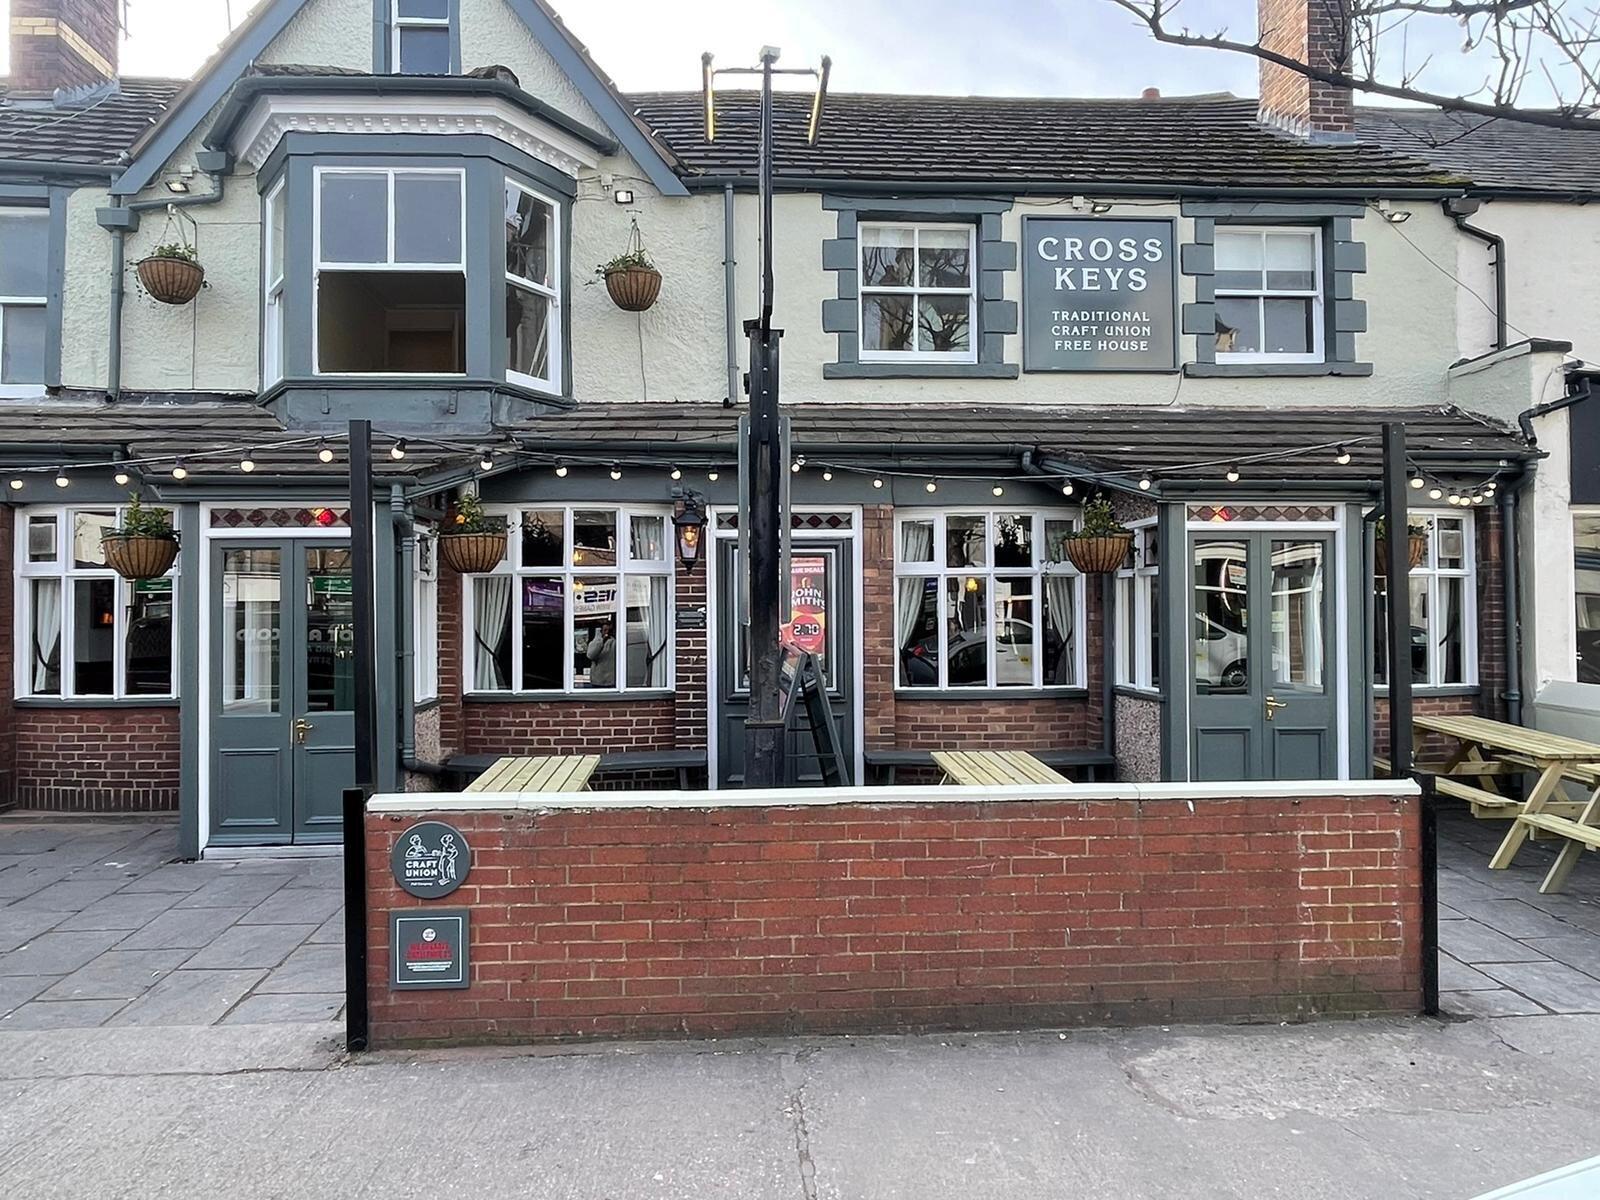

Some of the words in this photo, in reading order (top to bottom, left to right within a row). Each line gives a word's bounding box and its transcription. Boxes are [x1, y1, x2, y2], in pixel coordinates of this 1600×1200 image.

[1037, 237, 1163, 261] CROSS
[1054, 267, 1147, 291] KEYS
[1051, 310, 1150, 322] TRADITIONAL
[1051, 325, 1098, 336] CRAFT
[1104, 326, 1151, 336] UNION
[1054, 340, 1092, 350] FREE
[1098, 340, 1149, 351] HOUSE
[793, 624, 820, 635] 2.70
[405, 860, 437, 869] CRAFT
[405, 868, 438, 877] UNION
